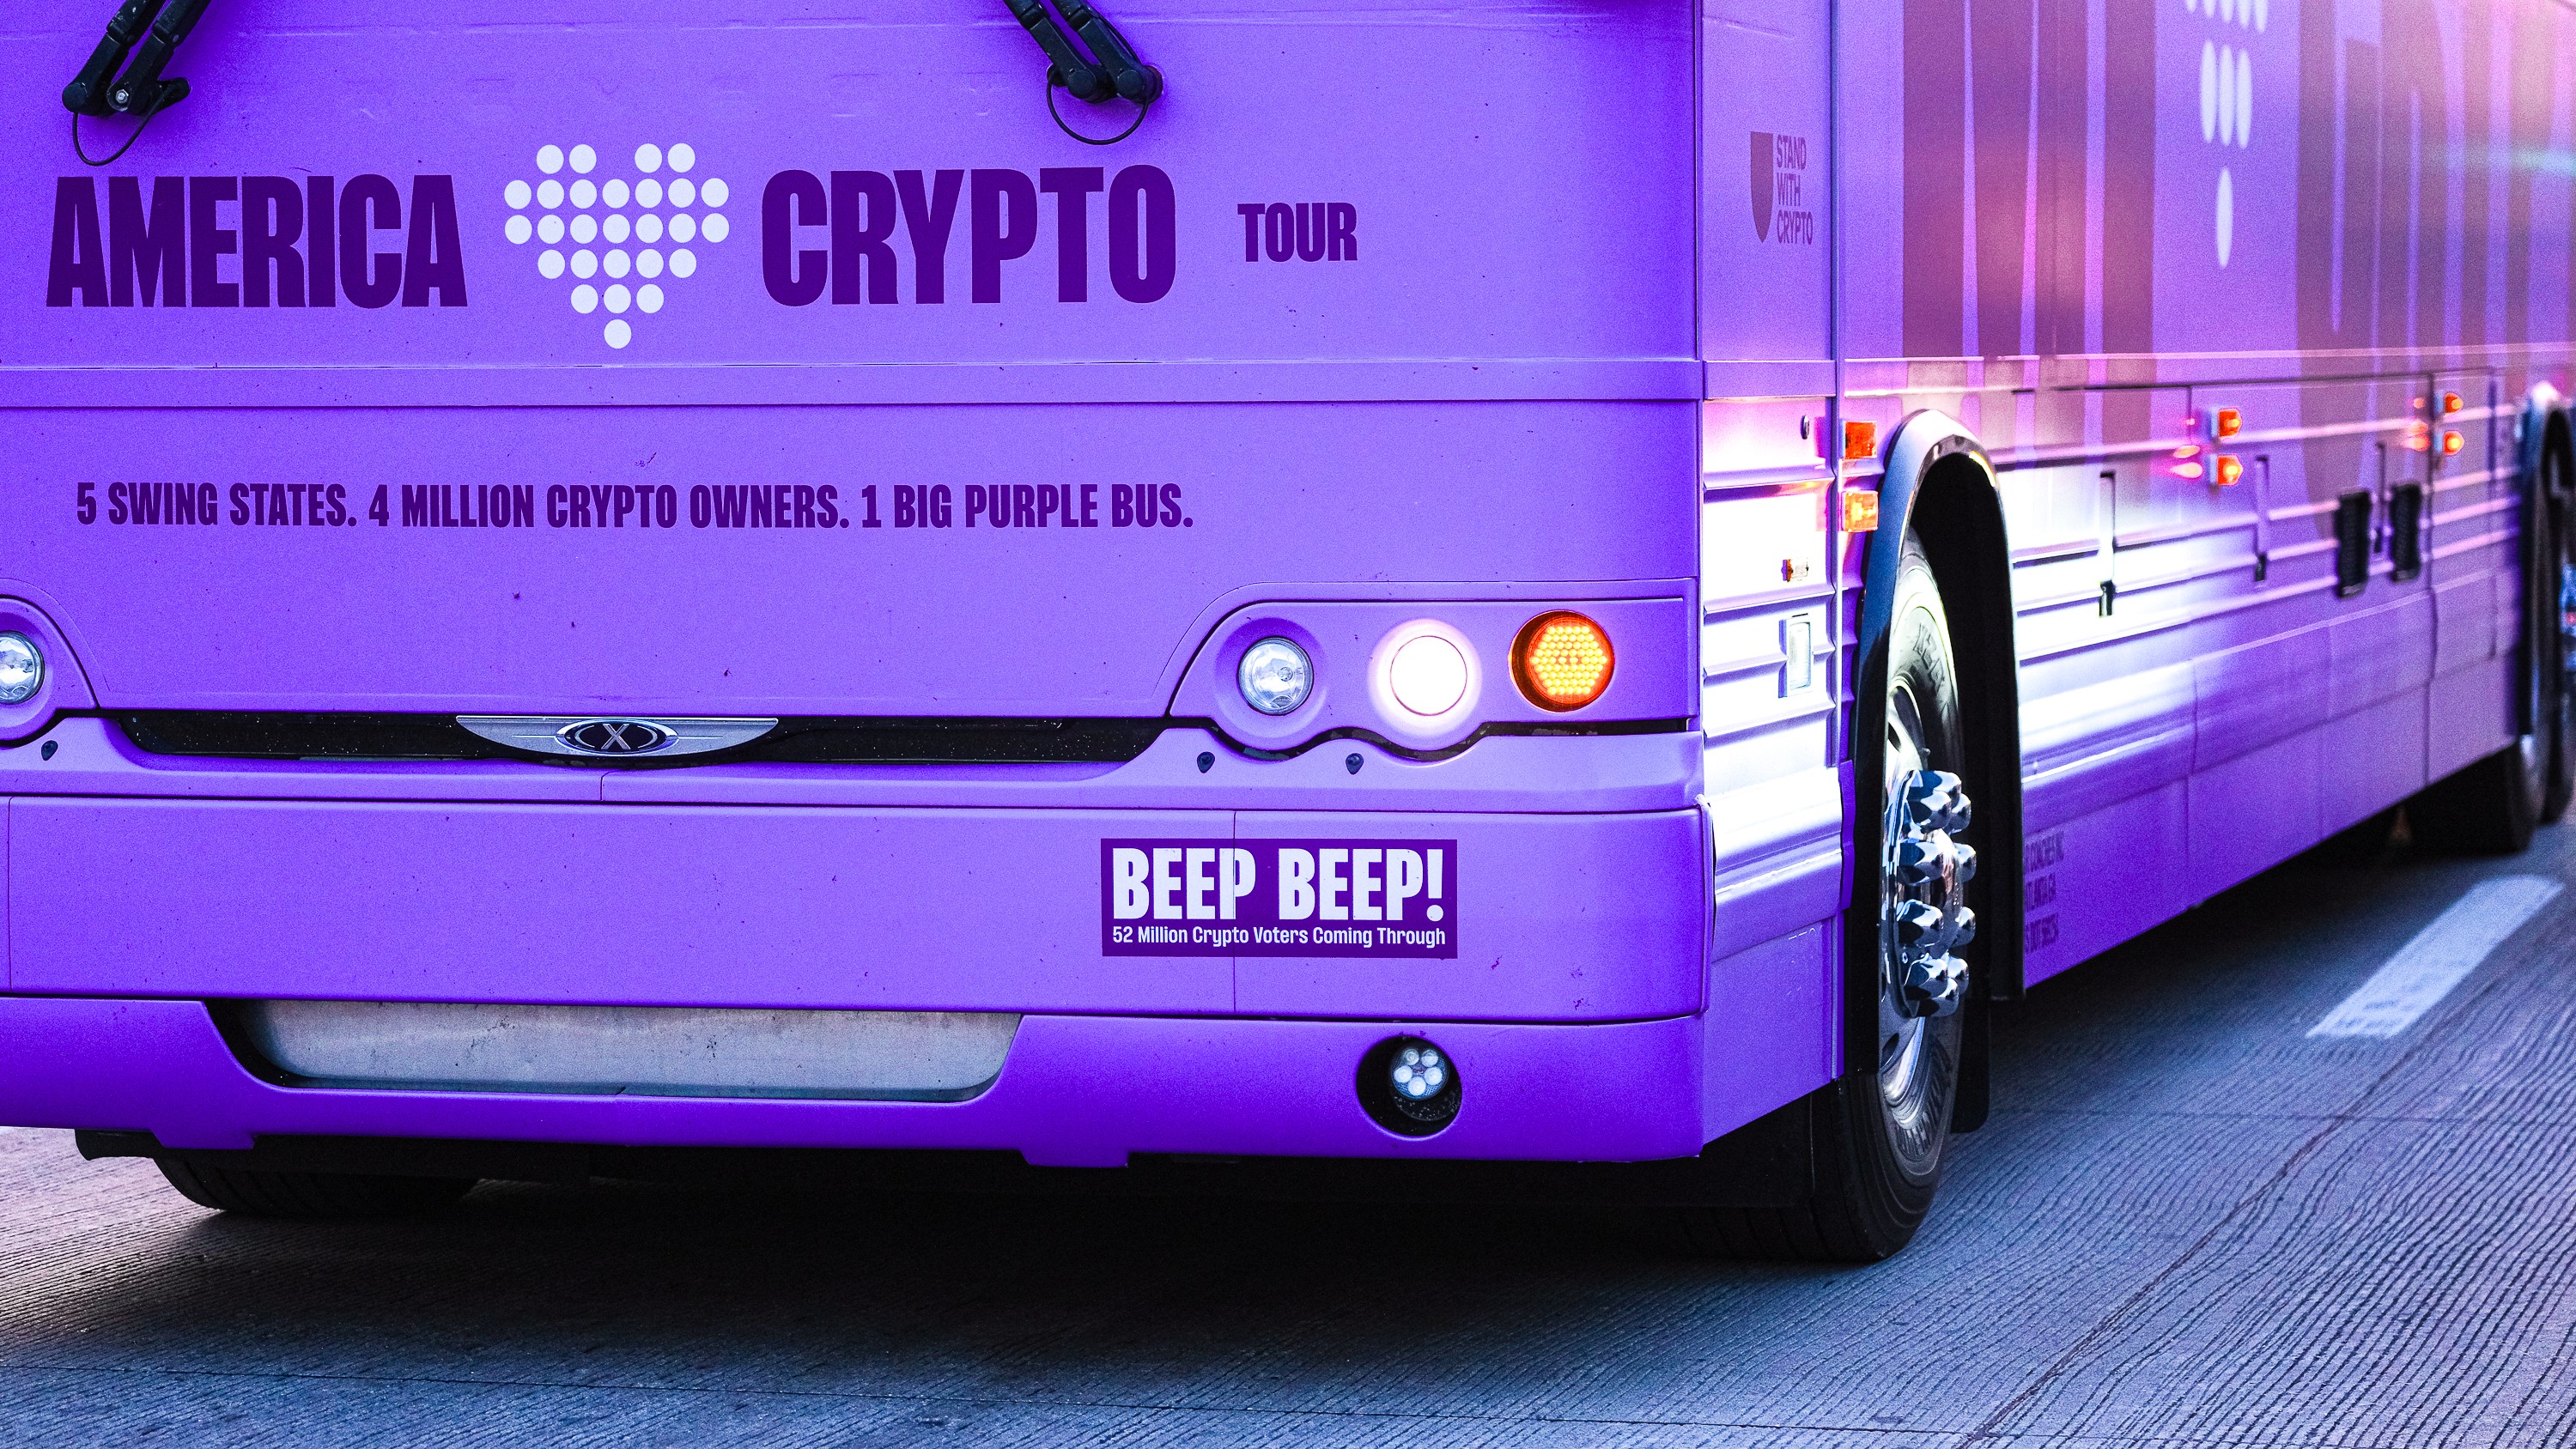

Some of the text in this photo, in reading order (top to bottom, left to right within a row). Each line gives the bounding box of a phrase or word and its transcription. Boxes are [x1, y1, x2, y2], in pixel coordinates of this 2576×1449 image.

[1777, 134, 1807, 170] STAND
[1777, 173, 1801, 206] WITH
[46, 165, 1357, 308] AMERICA CRYPTO TOUR
[1777, 209, 1813, 245] CRYPTO
[77, 482, 1193, 528] 5 SWING STATES. 4 MILLION CRYPTO OWNERS. 1 BIG PURPLE BUS.
[1113, 848, 1443, 921] BEEP BEEP!
[1113, 926, 1446, 948] 52 Million Crypto Voters Coming Through
